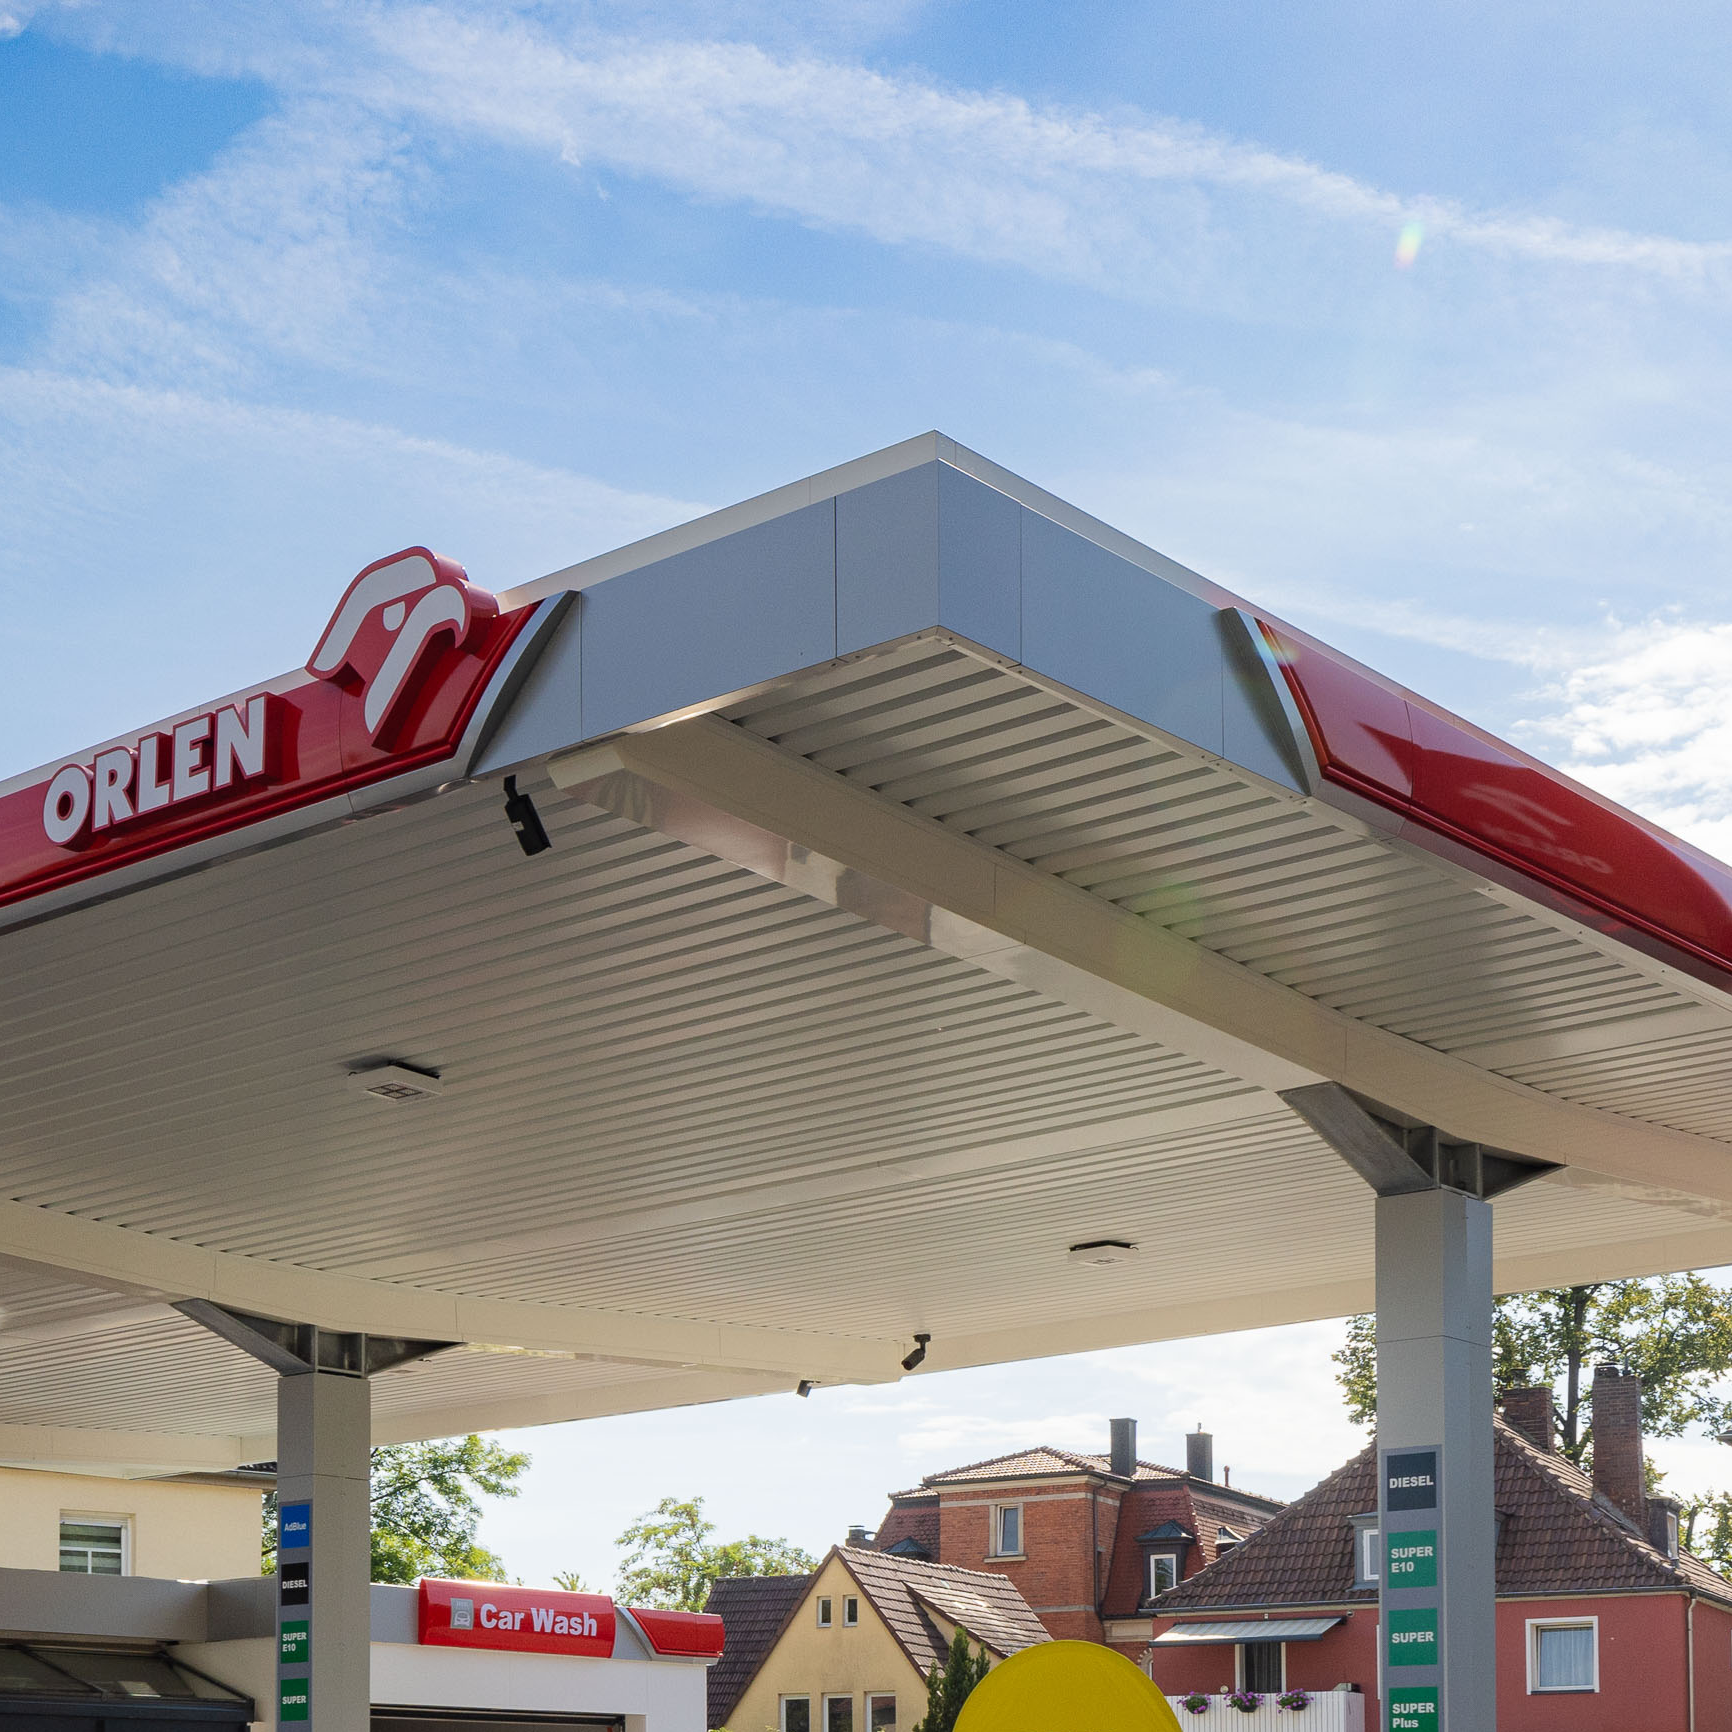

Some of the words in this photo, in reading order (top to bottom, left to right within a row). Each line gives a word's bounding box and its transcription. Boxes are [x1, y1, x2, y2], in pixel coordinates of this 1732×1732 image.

[42, 694, 271, 845] ORLEN
[1389, 1475, 1434, 1489] DIESEL
[284, 1522, 307, 1532] AdBlue
[1391, 1546, 1433, 1559] SUPER
[1391, 1561, 1414, 1573] E10
[282, 1579, 308, 1589] DIESEL
[480, 1603, 525, 1630] Car
[530, 1607, 598, 1637] Wash
[282, 1632, 307, 1642] SUPER
[1392, 1631, 1434, 1643] SUPER
[282, 1643, 296, 1652] E10
[282, 1695, 307, 1705] SUPER
[1392, 1702, 1435, 1714] SUPER
[1392, 1717, 1419, 1729] Plus
